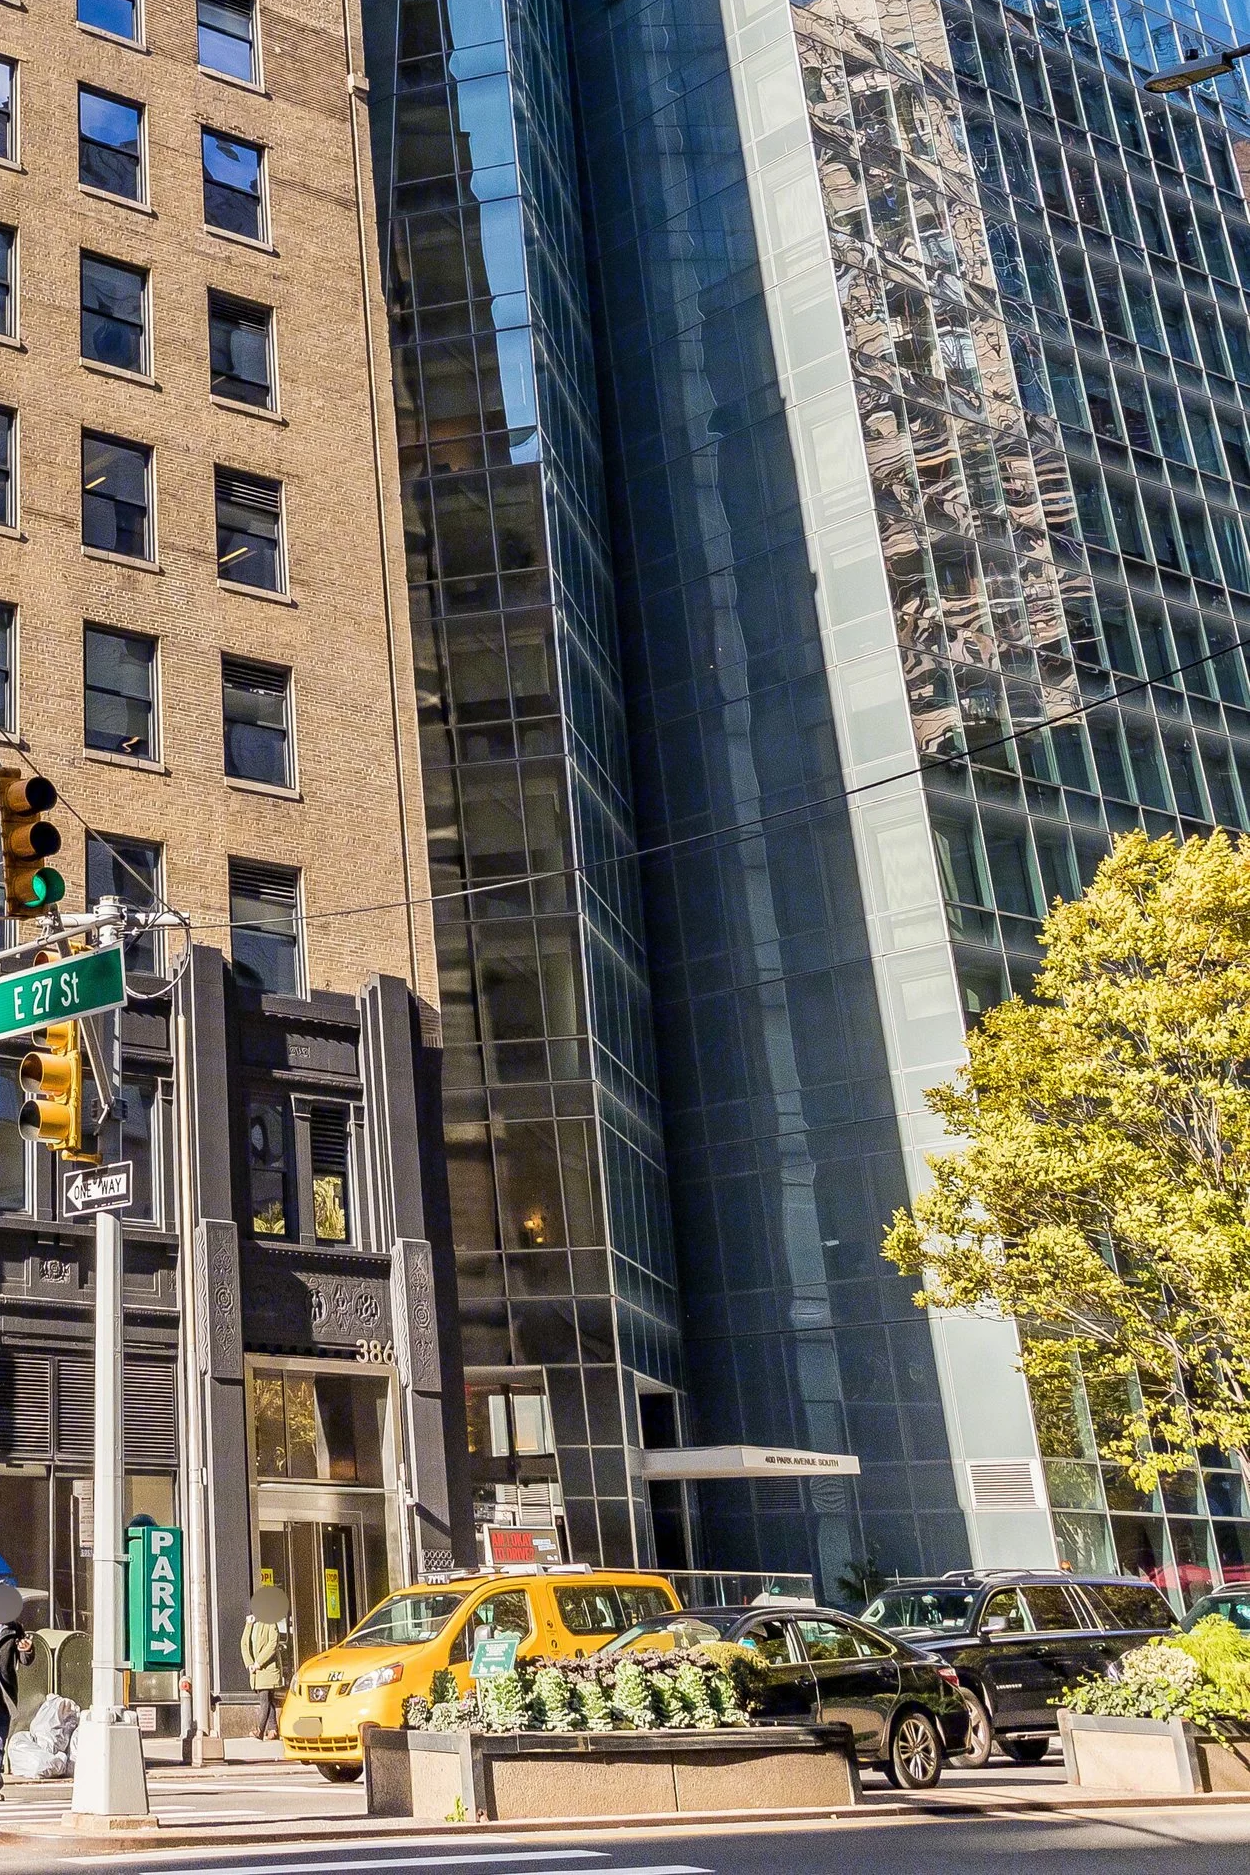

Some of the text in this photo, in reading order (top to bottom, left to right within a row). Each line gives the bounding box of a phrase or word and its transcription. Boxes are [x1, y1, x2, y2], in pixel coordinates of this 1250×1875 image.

[14, 971, 80, 1020] E 27 St
[73, 1177, 122, 1200] ONE WAY
[355, 1338, 396, 1365] 386
[764, 1455, 839, 1467] 400 PARK AVENUE SOUTH
[491, 1532, 505, 1546] AM
[510, 1532, 533, 1547] OKAY
[494, 1547, 505, 1562] TO
[151, 1530, 176, 1633] PARK
